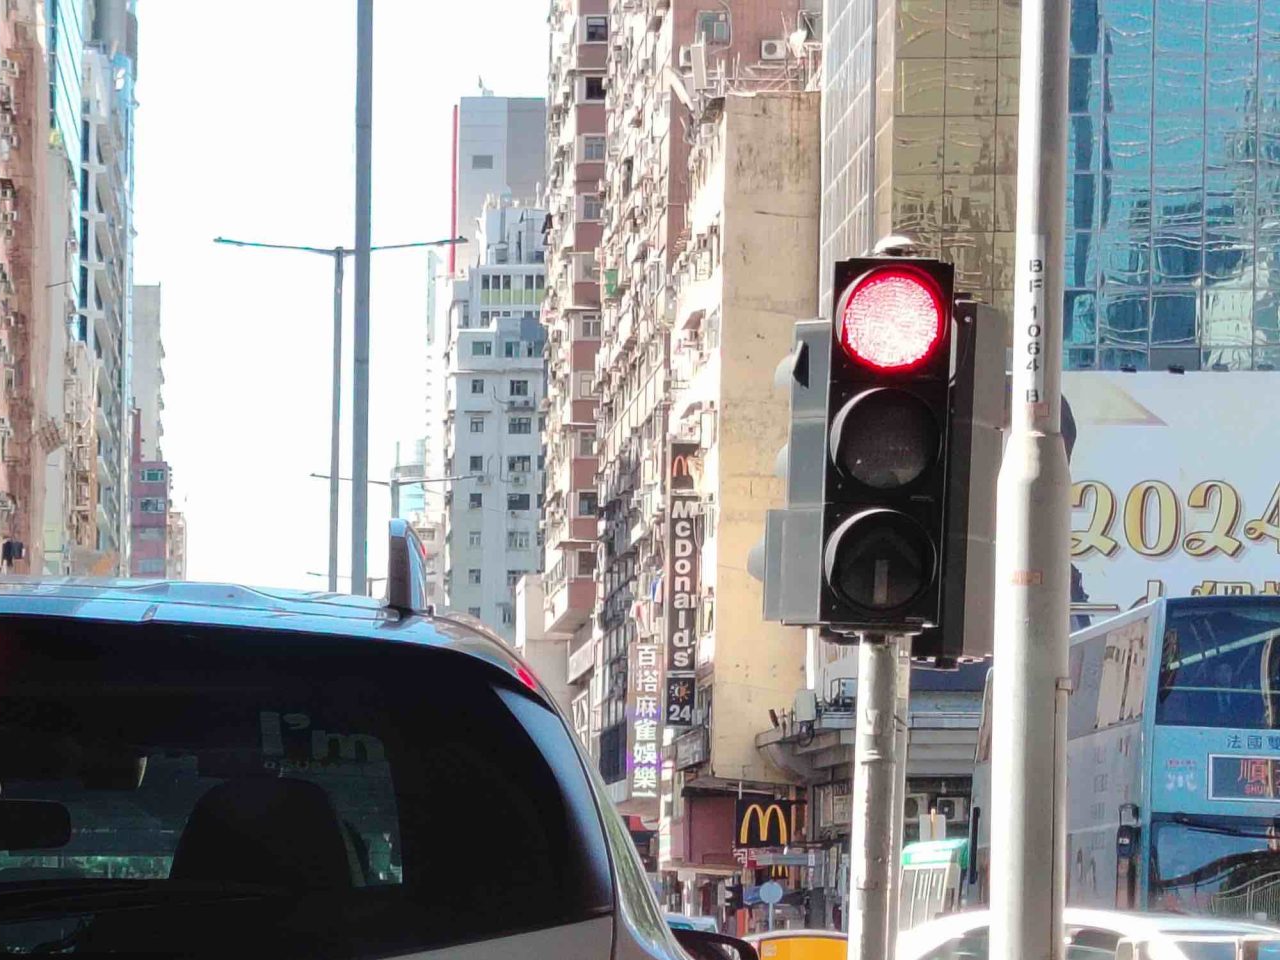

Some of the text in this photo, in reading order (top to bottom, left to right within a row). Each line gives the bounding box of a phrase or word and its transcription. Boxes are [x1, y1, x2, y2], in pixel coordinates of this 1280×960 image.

[671, 500, 698, 668] McDonald's
[669, 704, 691, 721] 24
[1237, 758, 1280, 786] 順
